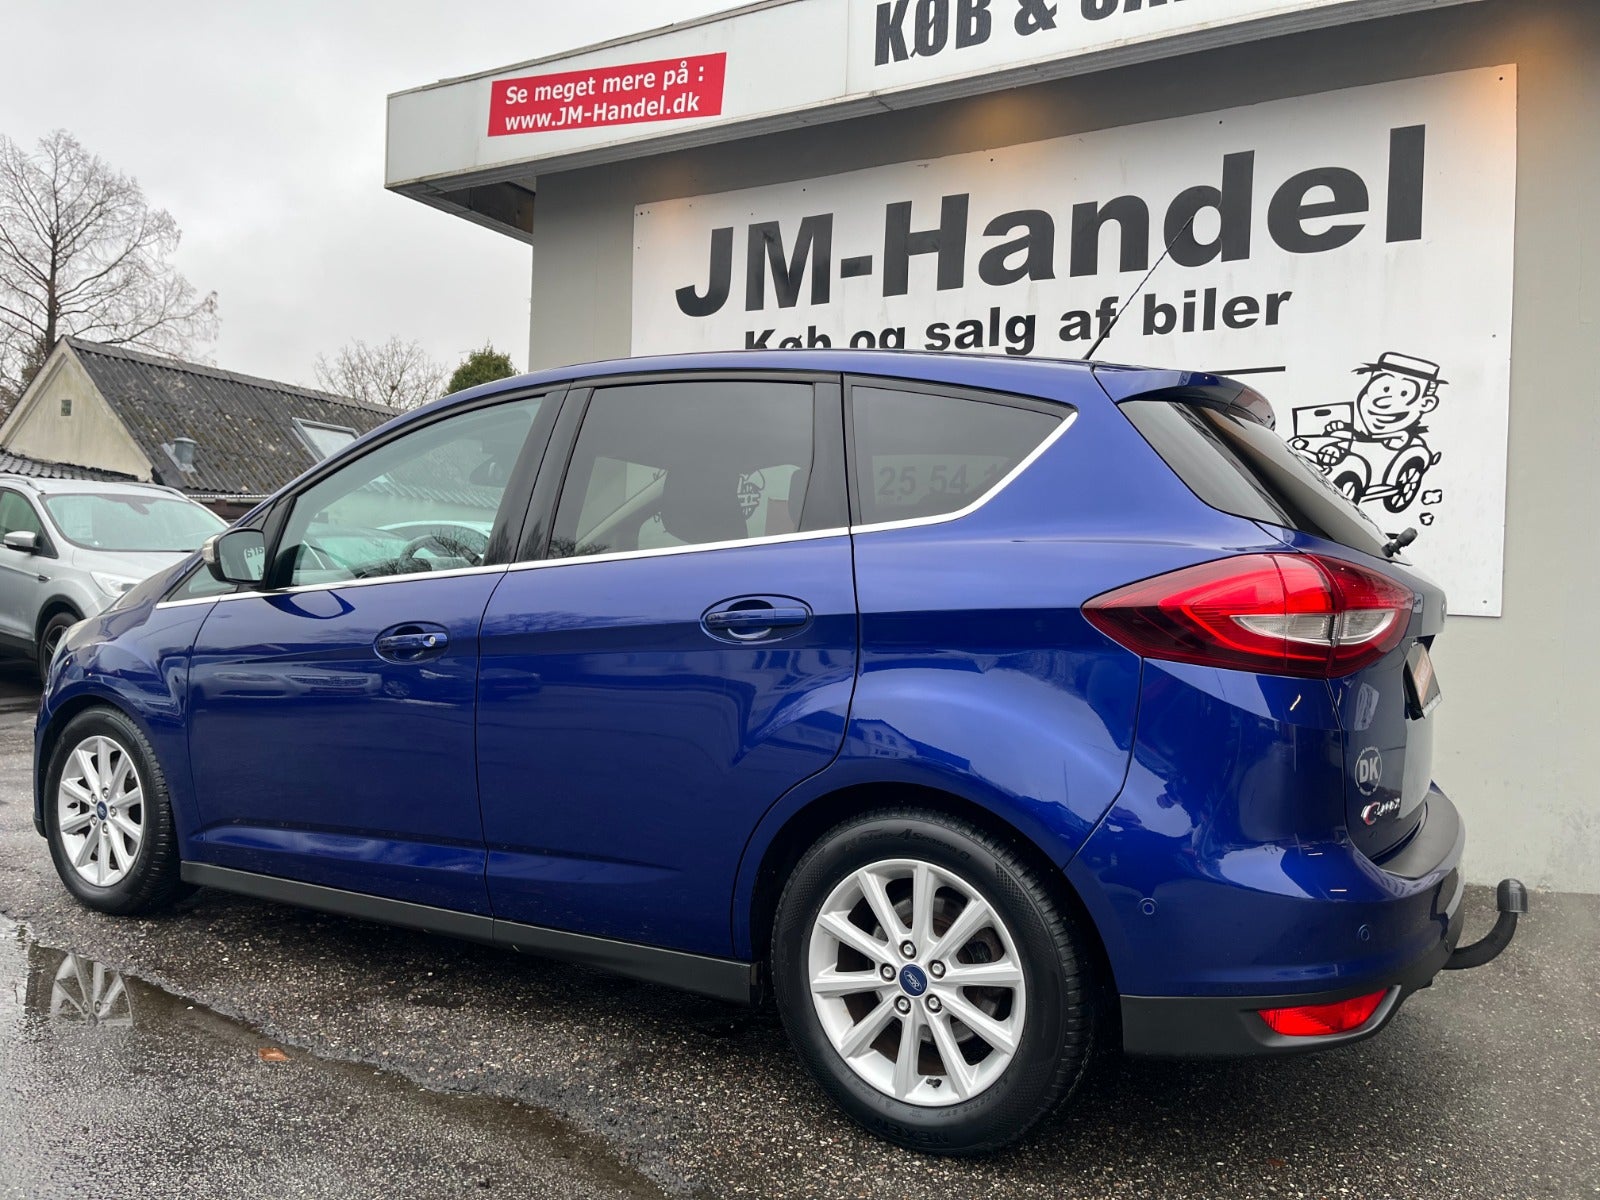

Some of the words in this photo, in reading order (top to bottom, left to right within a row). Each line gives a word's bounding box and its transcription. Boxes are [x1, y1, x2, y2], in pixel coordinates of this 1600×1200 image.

[874, 0, 992, 66] KØB
[505, 86, 528, 105] Se
[534, 77, 596, 103] meget
[602, 71, 656, 94] mere
[662, 60, 689, 91] på
[504, 91, 700, 131] www.JM-Handel.dk
[674, 123, 1426, 318] JM-Handel
[924, 306, 1037, 356] salg
[1058, 295, 1120, 342] af
[1142, 287, 1293, 336] biler
[1360, 757, 1379, 784] DK
